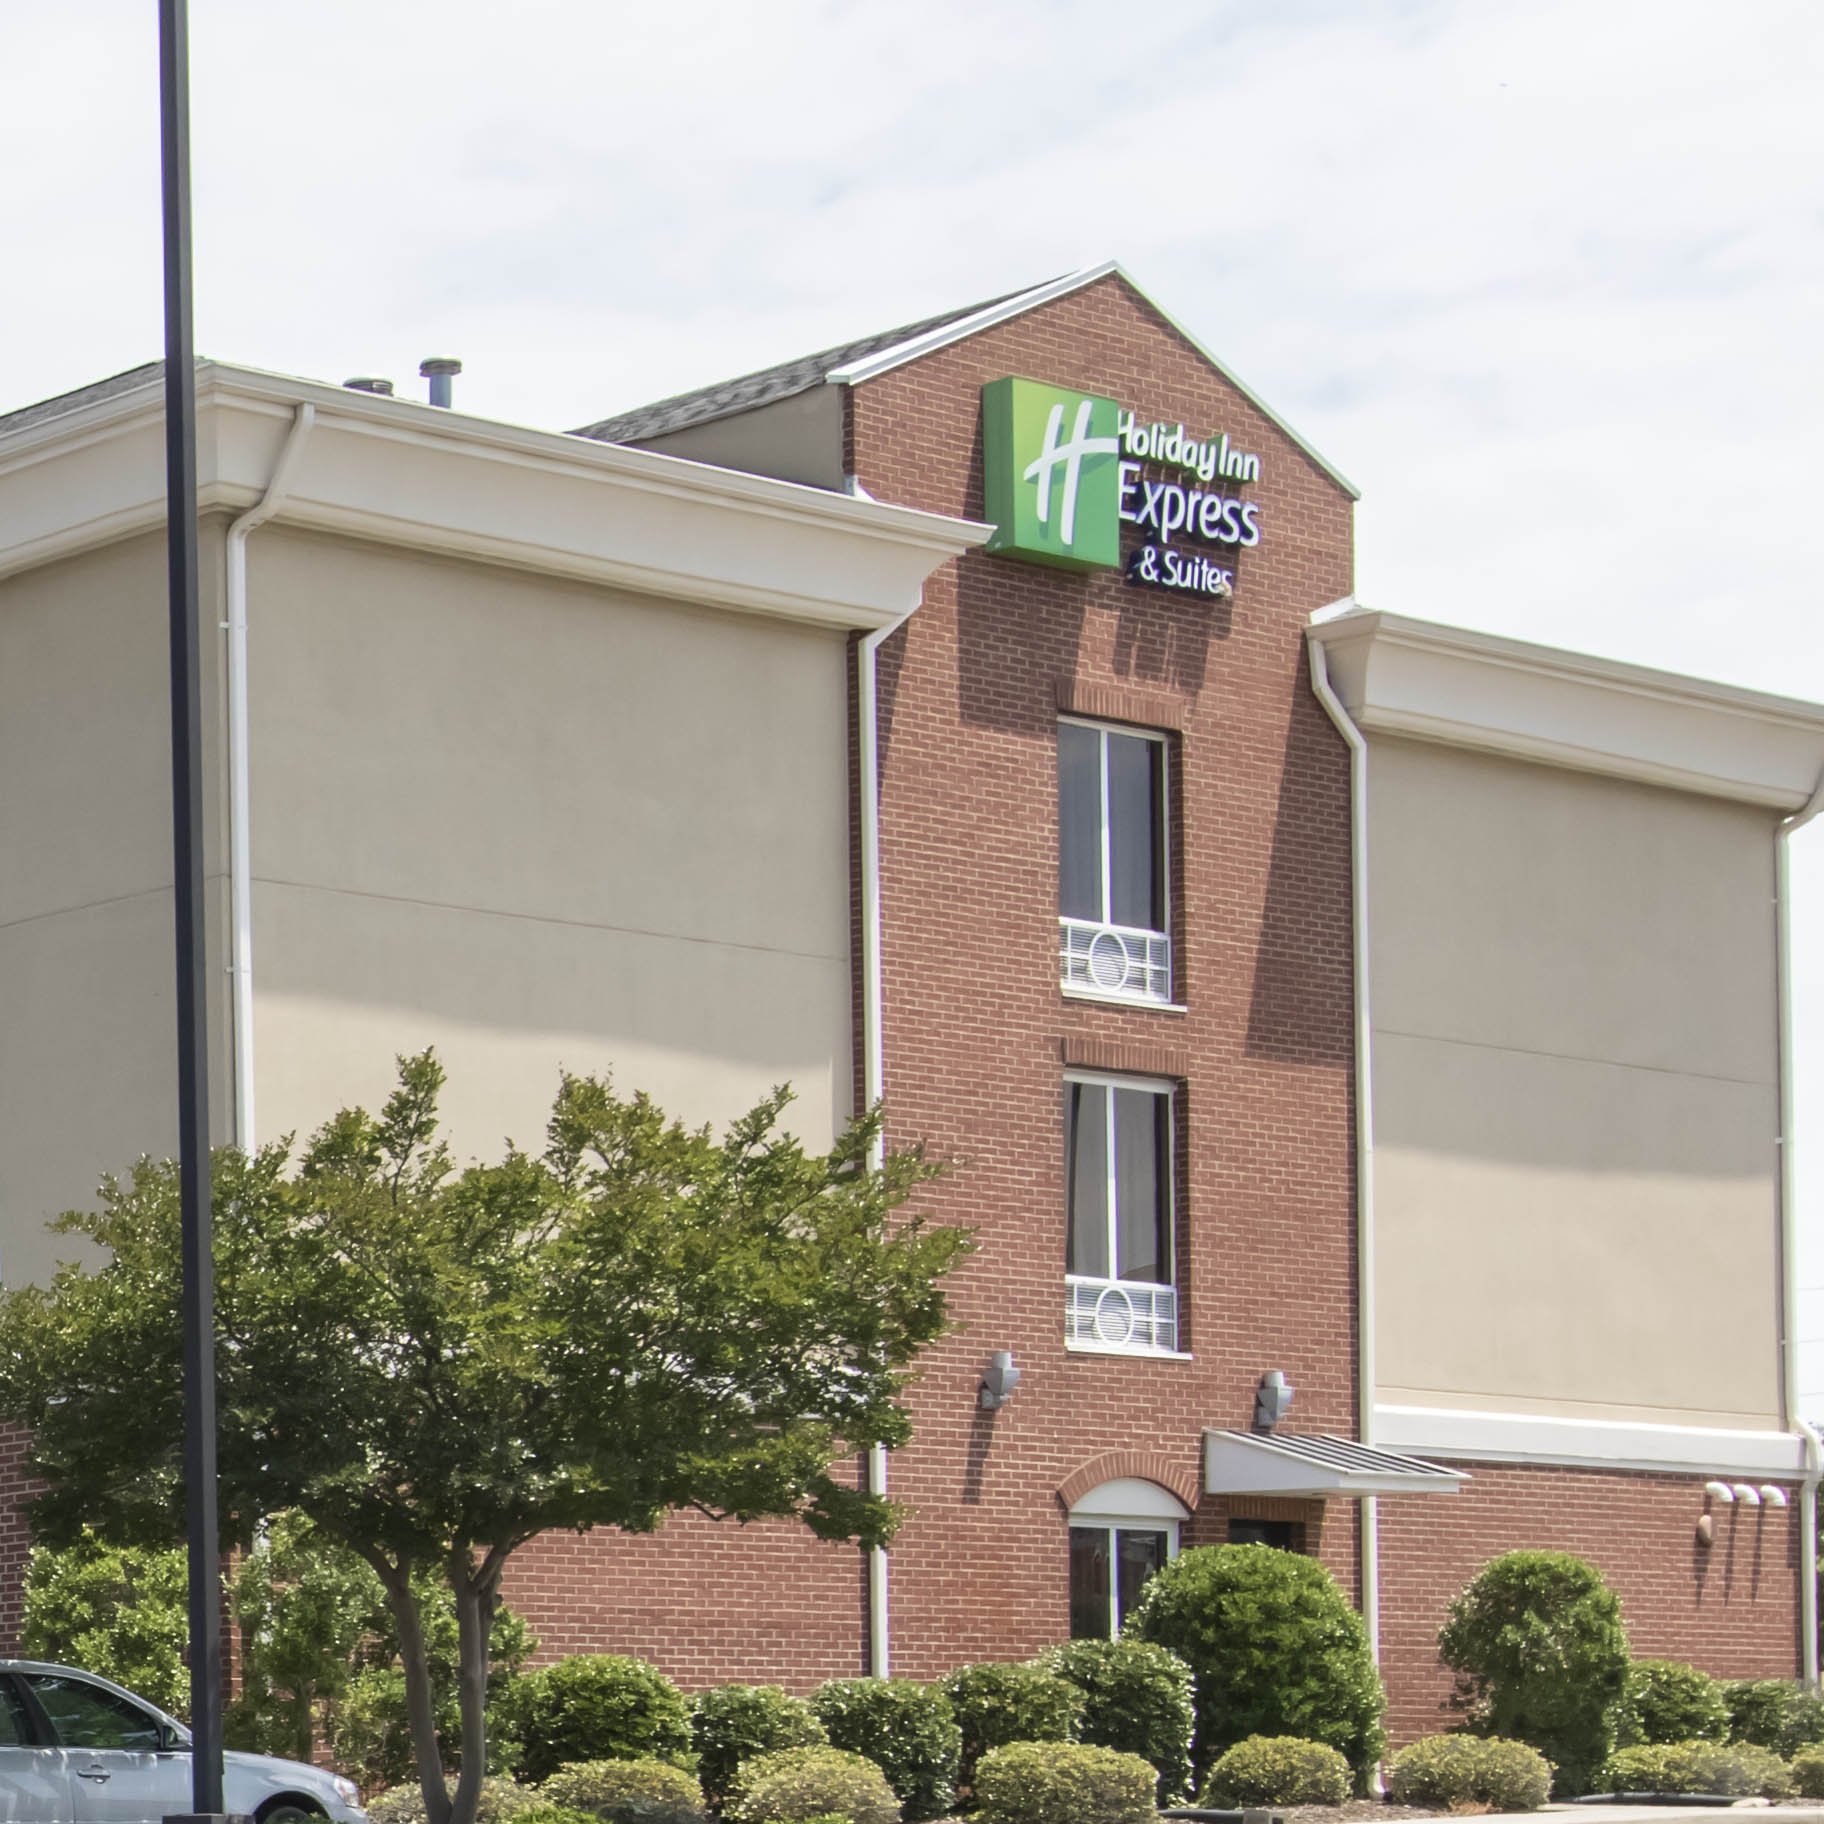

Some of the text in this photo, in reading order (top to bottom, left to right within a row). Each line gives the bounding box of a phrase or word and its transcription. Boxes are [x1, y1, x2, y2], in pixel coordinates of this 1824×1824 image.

[1118, 410, 1261, 483] Holiday Inn
[1118, 461, 1261, 547] Express
[1139, 546, 1234, 598] & Suites
